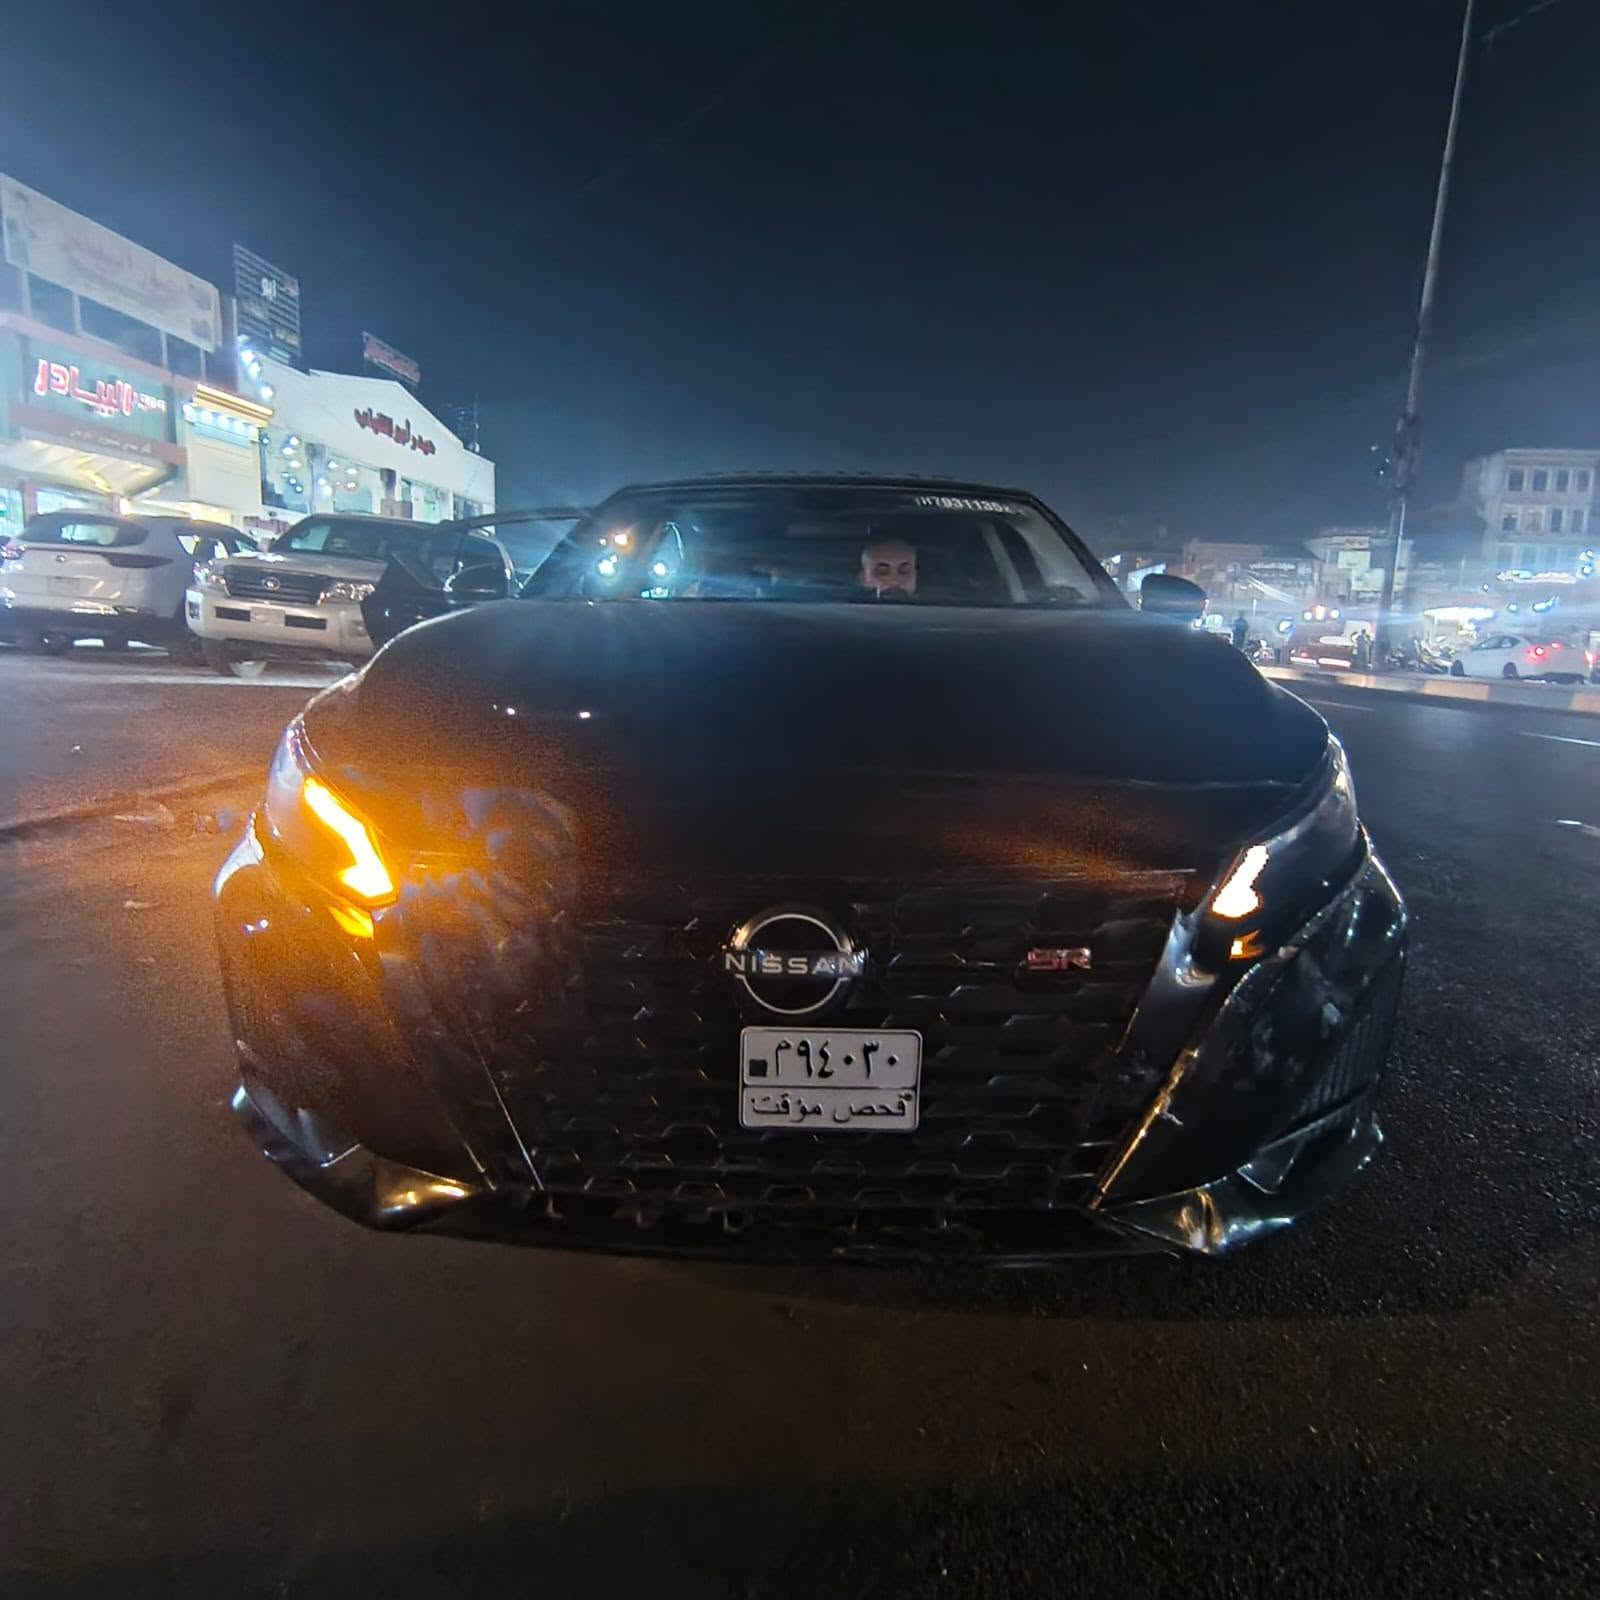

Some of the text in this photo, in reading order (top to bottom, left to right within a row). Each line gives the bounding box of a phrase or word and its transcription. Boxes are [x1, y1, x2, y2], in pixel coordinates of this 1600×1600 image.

[724, 951, 864, 975] NISSAN
[751, 1091, 912, 1123] فحص مؤقت
